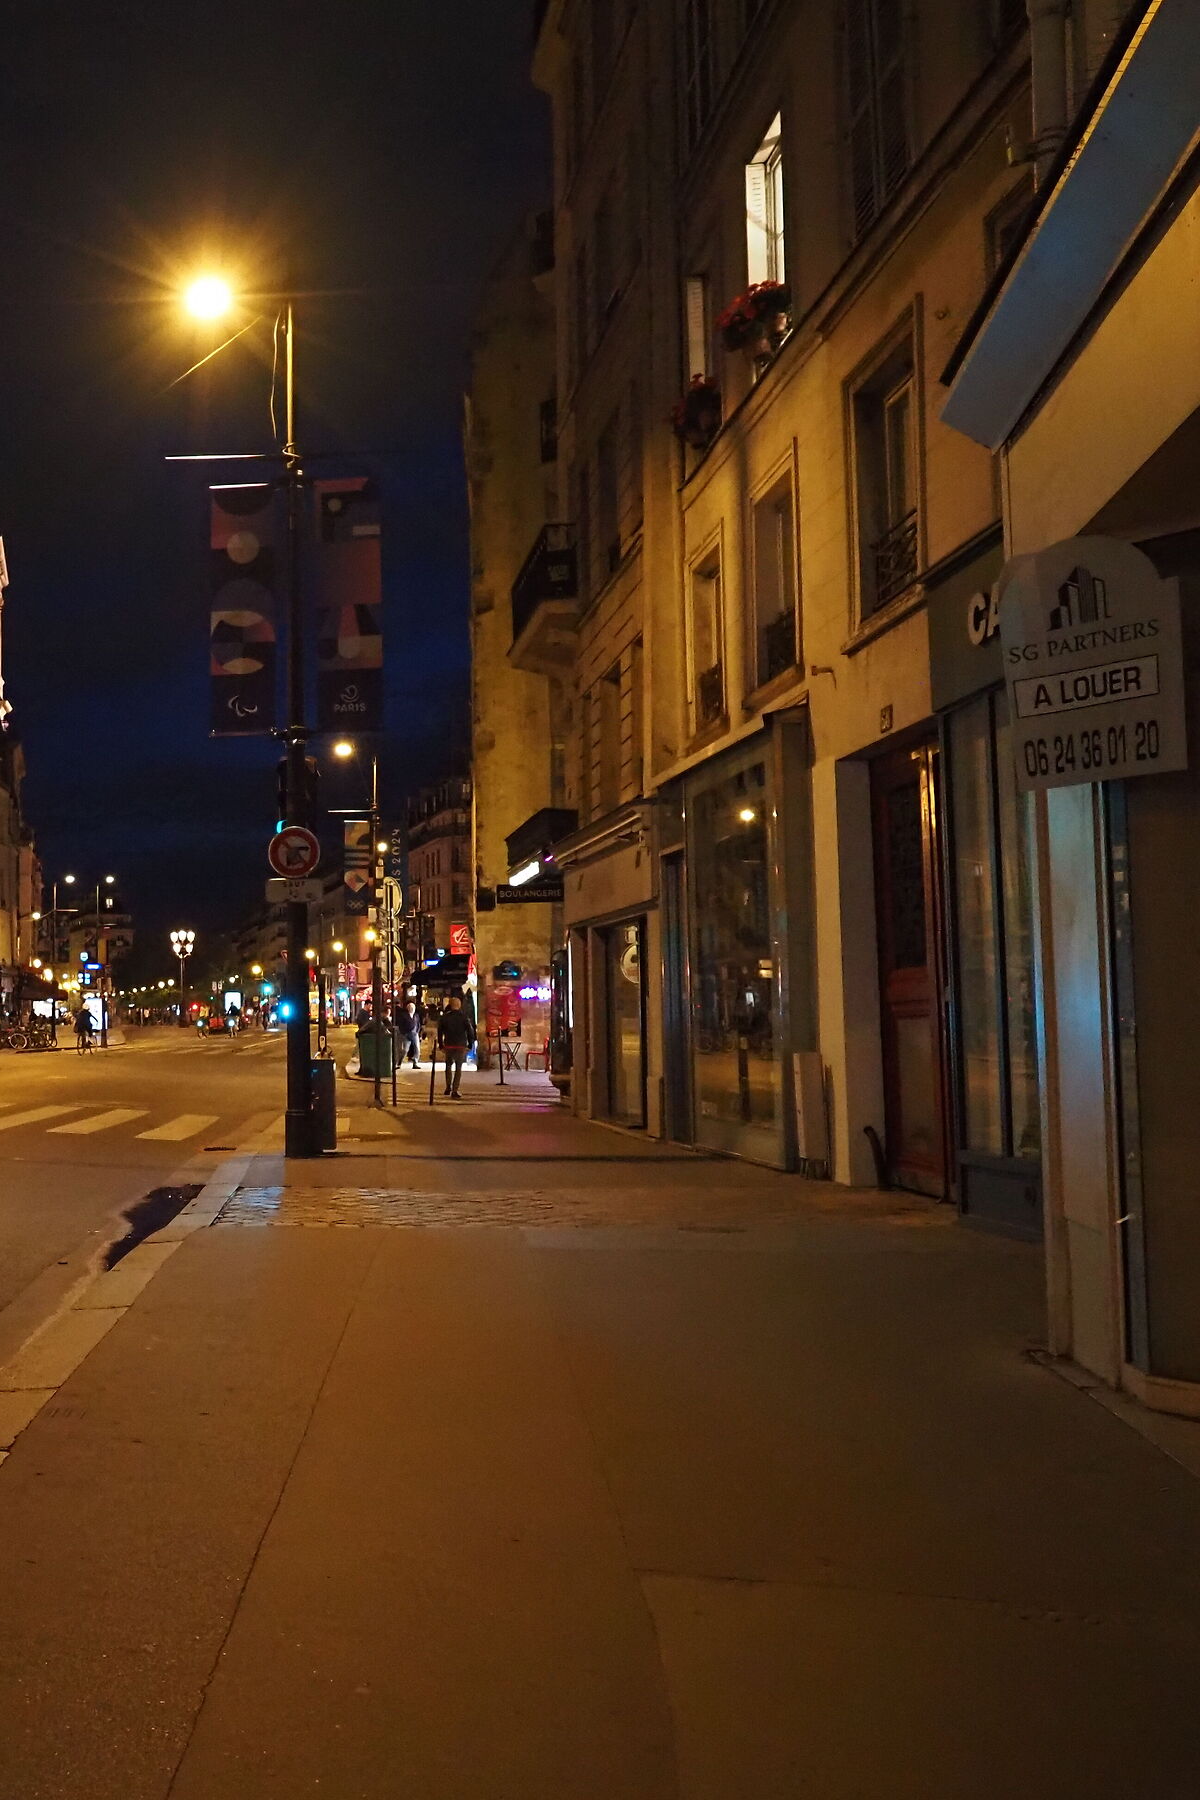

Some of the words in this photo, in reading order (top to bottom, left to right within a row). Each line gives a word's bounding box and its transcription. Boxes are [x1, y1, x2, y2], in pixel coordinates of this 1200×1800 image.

[1009, 644, 1039, 664] SG
[1047, 619, 1160, 658] PARTNERS
[333, 701, 368, 713] PARIS
[1034, 684, 1053, 709] A
[1060, 666, 1142, 705] LOUER
[1024, 738, 1049, 777] 06
[1054, 734, 1076, 773] 24
[1081, 730, 1103, 769] 36
[1108, 726, 1127, 765] 01
[1135, 720, 1160, 760] 20
[499, 889, 562, 898] BOULANGERIE
